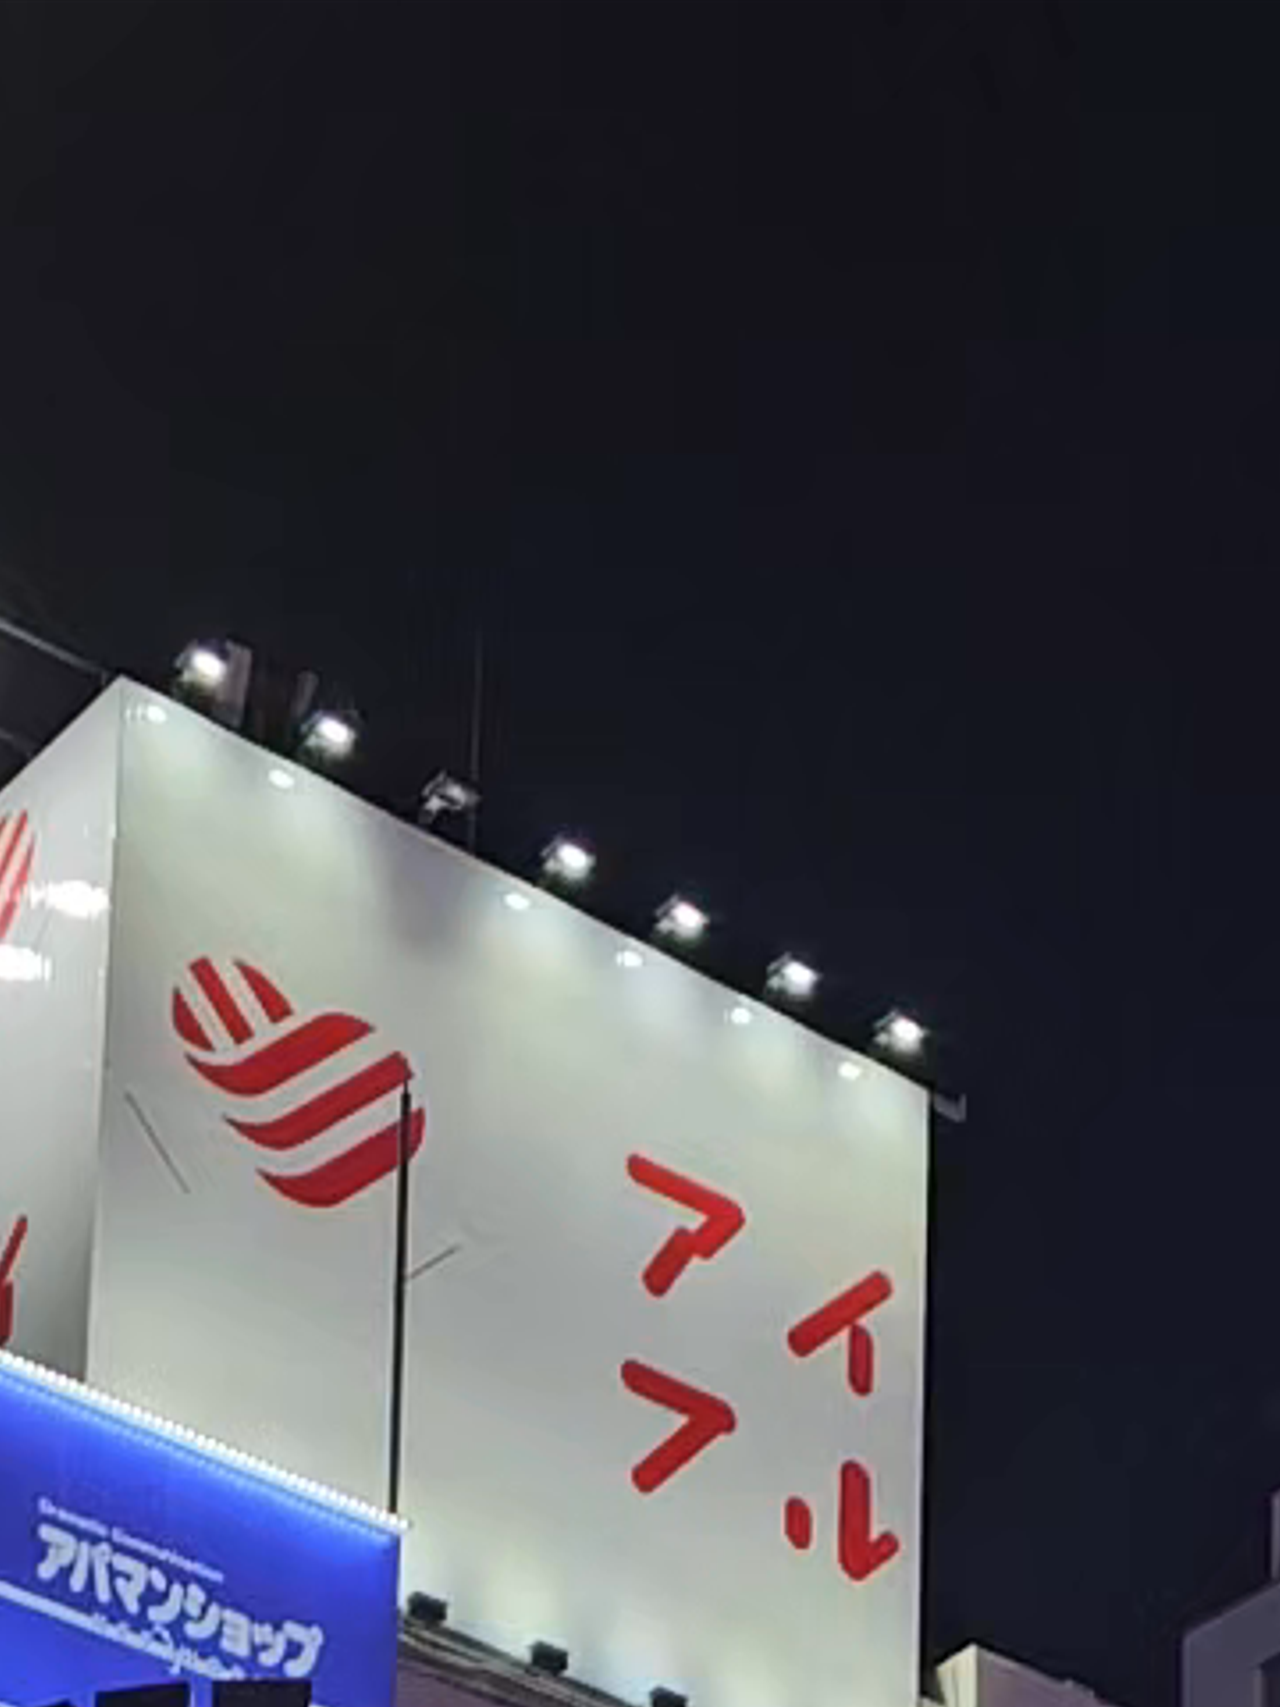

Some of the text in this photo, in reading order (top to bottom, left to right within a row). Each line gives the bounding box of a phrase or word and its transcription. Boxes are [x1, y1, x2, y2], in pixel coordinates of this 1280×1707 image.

[35, 1521, 325, 1679] アパマンショップ
